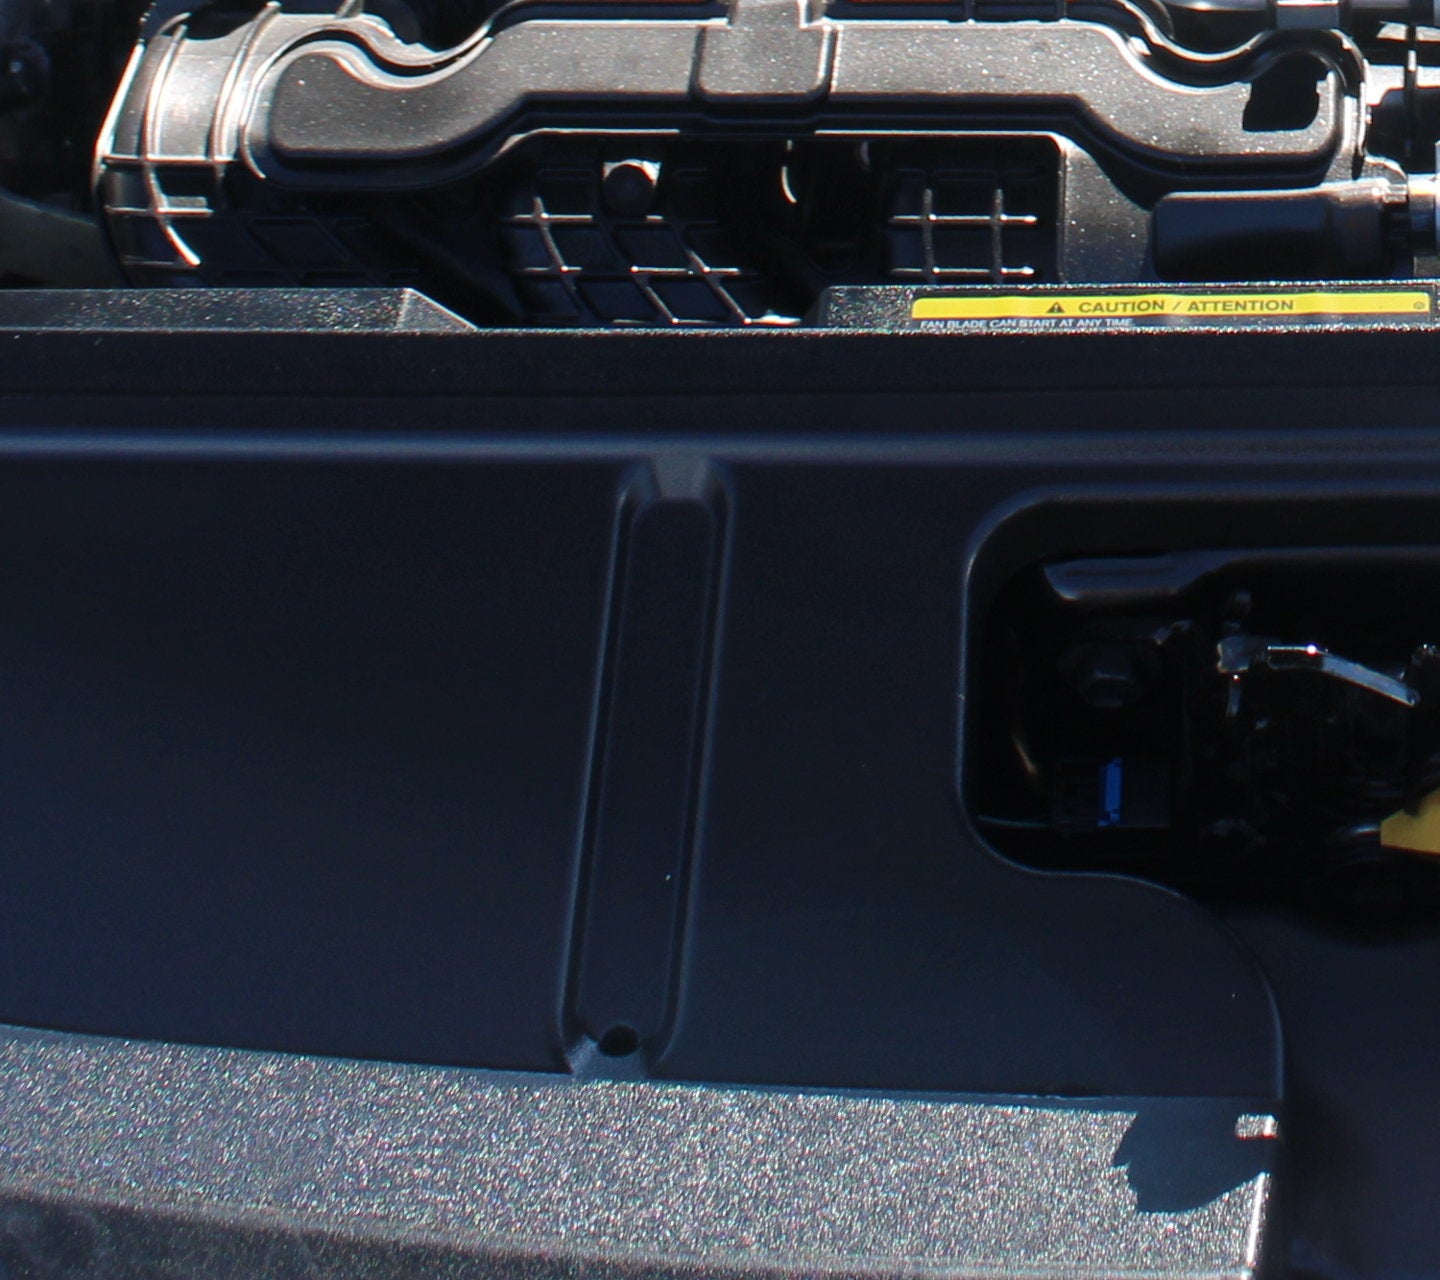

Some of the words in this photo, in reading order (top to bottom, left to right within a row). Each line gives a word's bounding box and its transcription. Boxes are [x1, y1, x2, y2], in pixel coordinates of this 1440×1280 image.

[1078, 300, 1165, 314] CAUTION
[1188, 300, 1294, 313] ATTENTION
[920, 320, 945, 329] FAN
[947, 320, 987, 328] BLADE
[989, 319, 1017, 328] CAN
[1019, 319, 1057, 328] START
[1059, 319, 1074, 328] AT
[1076, 319, 1103, 328] ANY
